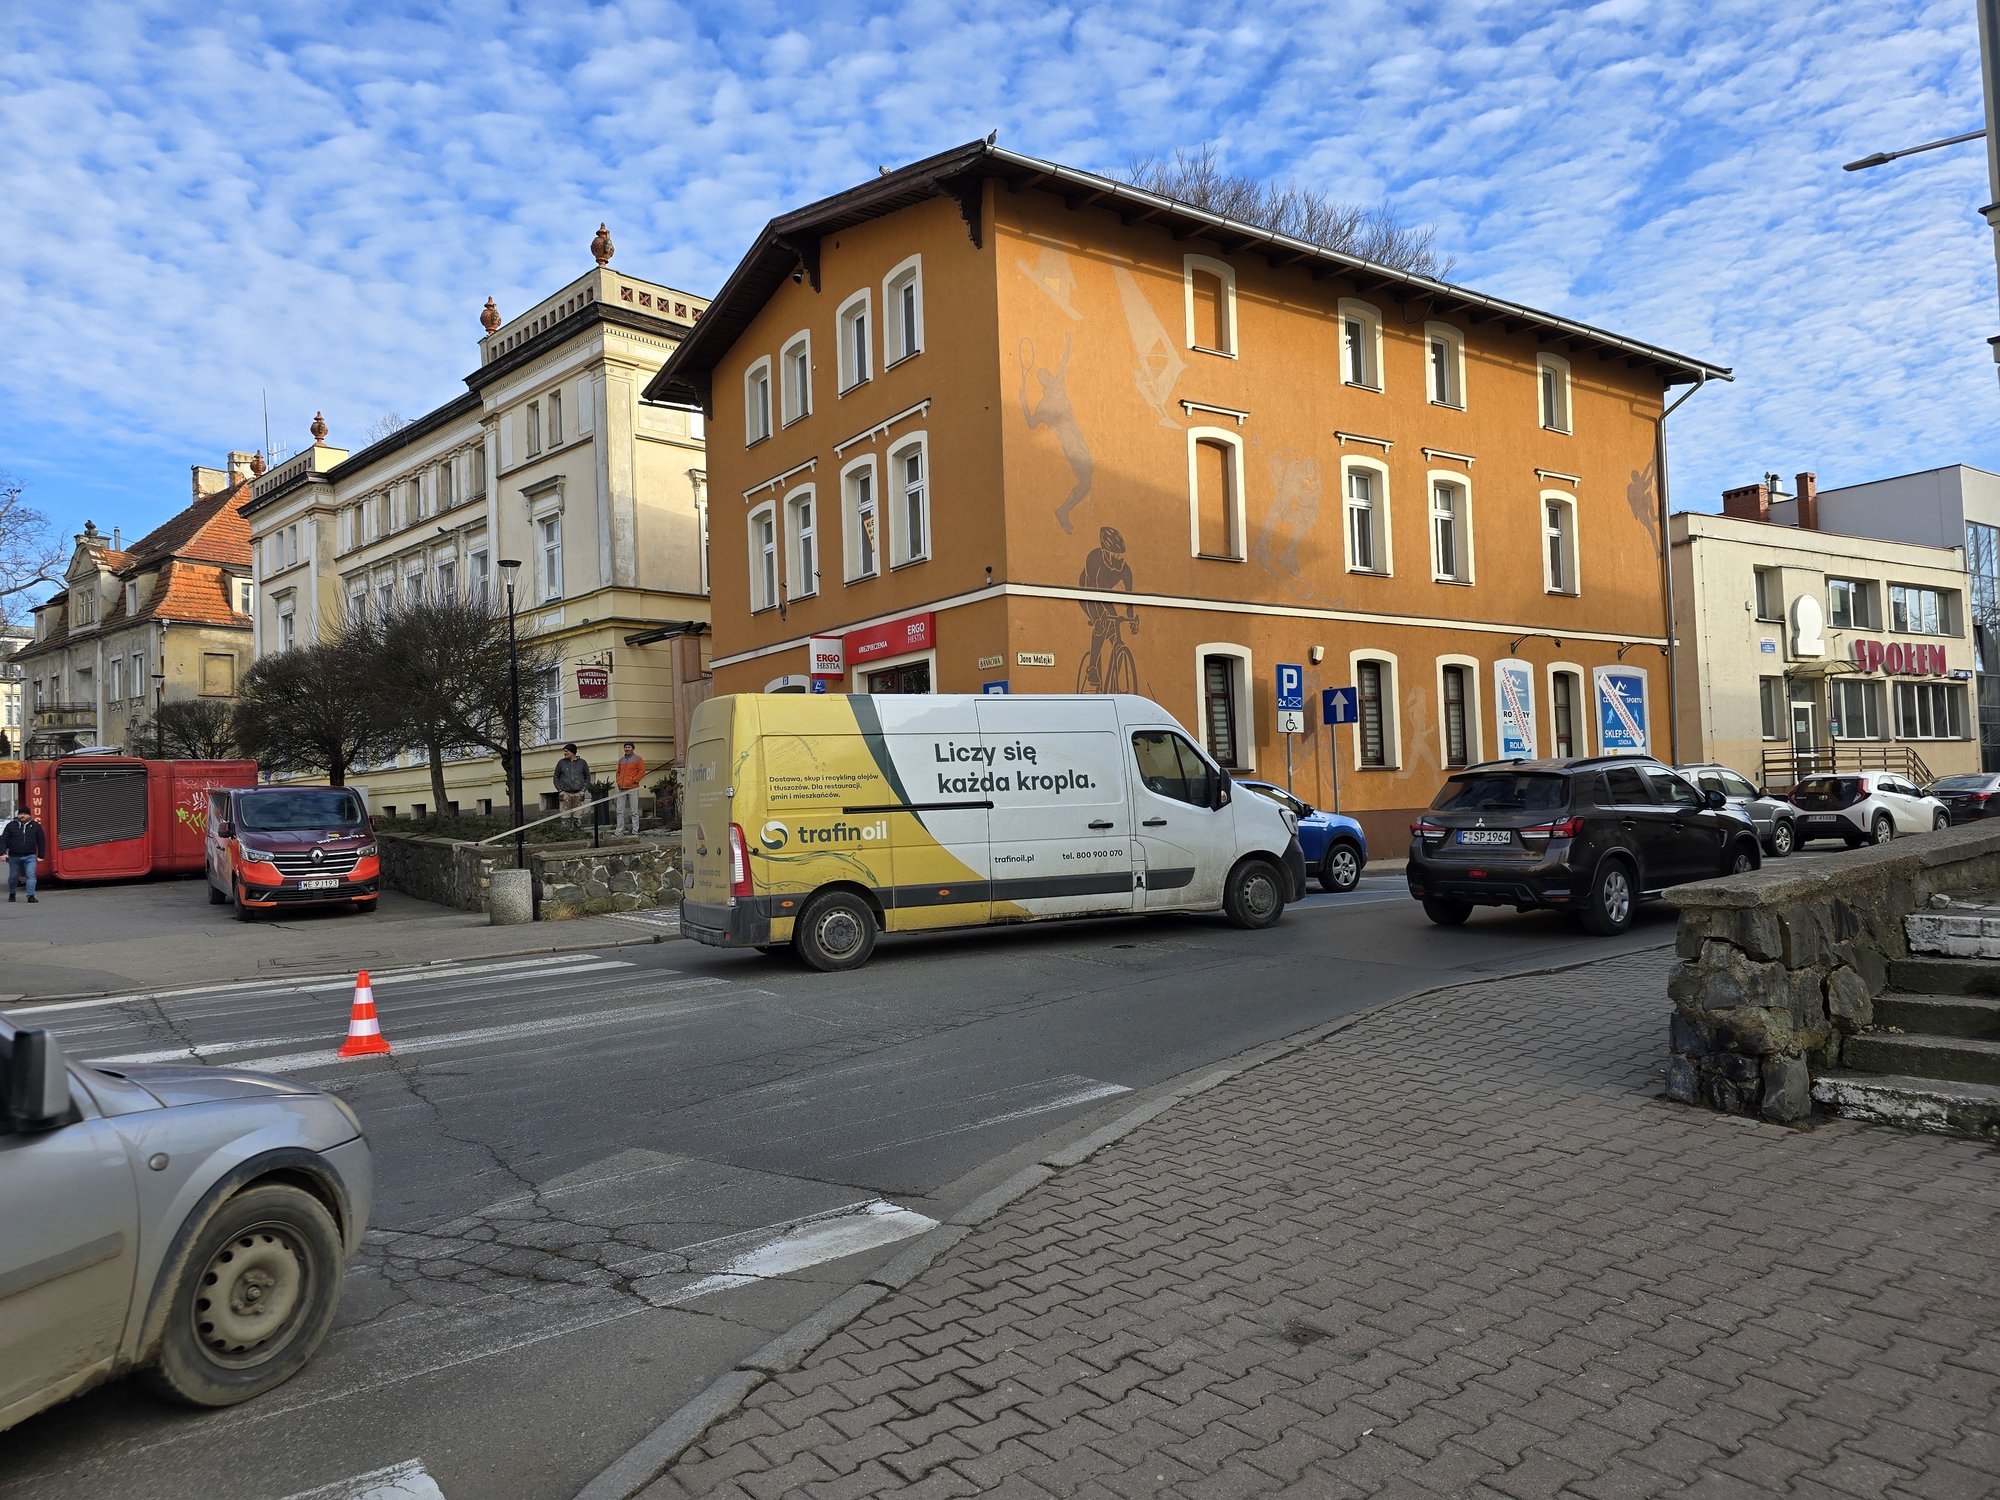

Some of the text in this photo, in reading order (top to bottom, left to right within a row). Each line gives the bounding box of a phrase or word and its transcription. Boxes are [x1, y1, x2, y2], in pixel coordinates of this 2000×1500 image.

[907, 622, 925, 635] ERGO
[907, 633, 925, 644] HESTIA
[858, 640, 888, 654] UBEZPIECZENIA
[816, 654, 840, 662] ERGO
[1020, 655, 1053, 665] Jana Matejki
[1852, 639, 1946, 675] SPOŁEM
[816, 662, 841, 670] HESTIA
[1283, 669, 1298, 697] P
[1605, 730, 1622, 739] SKLEP
[934, 741, 1037, 766] Liczy się
[769, 775, 803, 783] Dostawa,
[804, 775, 821, 784] skup
[825, 773, 856, 782] recykling
[857, 773, 879, 781] olejów
[938, 769, 1096, 794] każda kropla.
[774, 783, 810, 791] tłuszczów.
[793, 791, 840, 799] mieszkańców.
[798, 820, 888, 843] trafinoil
[1462, 831, 1510, 841] F SP 1964
[994, 854, 1035, 863] trafinoil.pl
[1076, 851, 1092, 859] 800
[1093, 850, 1108, 858] 900
[1109, 849, 1123, 857] 070
